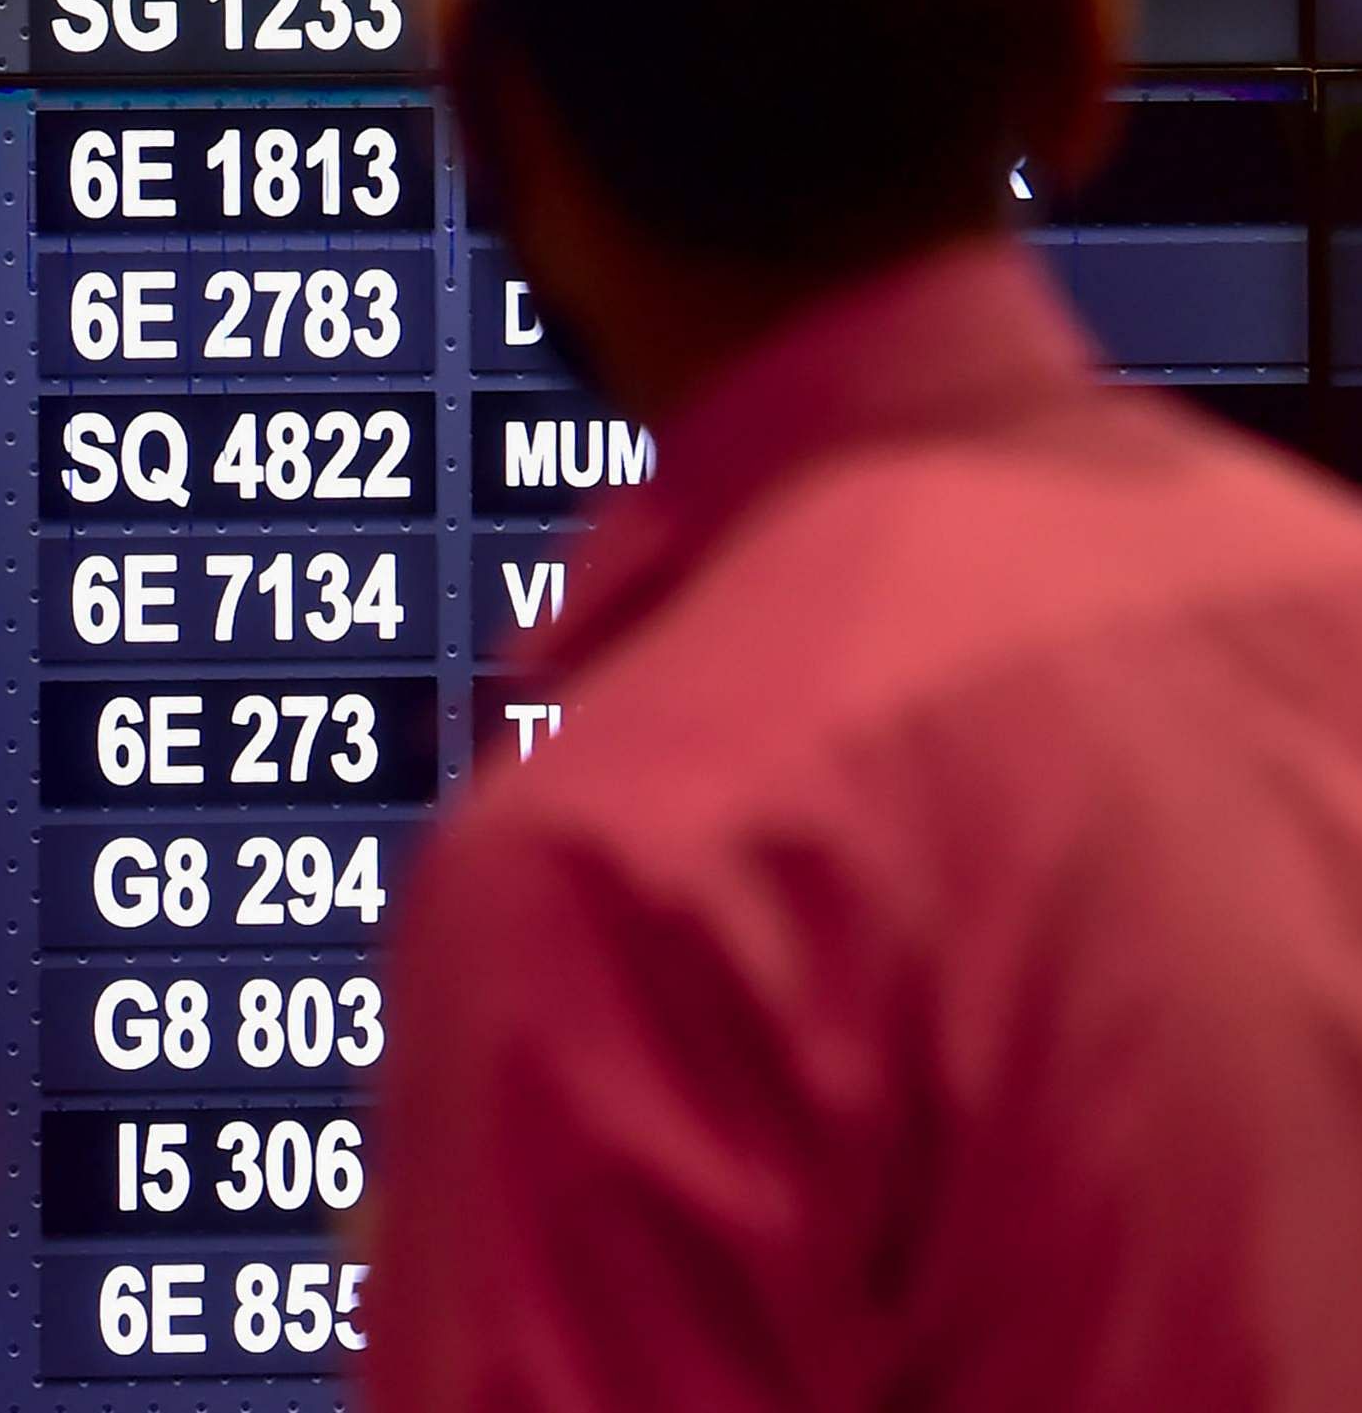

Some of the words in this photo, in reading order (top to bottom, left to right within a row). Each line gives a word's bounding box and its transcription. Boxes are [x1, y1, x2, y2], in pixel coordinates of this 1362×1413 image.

[69, 129, 177, 219] 6E
[206, 127, 400, 217] 1813
[70, 271, 178, 361] 6E
[203, 268, 401, 358] 2783
[61, 411, 191, 508] SQ
[213, 410, 411, 501] 4822
[505, 420, 655, 488] MUM
[72, 554, 179, 645] 6E
[206, 552, 404, 642] 7134
[97, 695, 205, 786] 6E
[230, 693, 379, 783] 273
[93, 837, 211, 928] G8
[235, 836, 386, 926] 294
[94, 979, 211, 1070] G8
[237, 977, 385, 1068] 803
[118, 1122, 191, 1212] I5
[215, 1119, 364, 1211] 306
[99, 1264, 207, 1356] 6E
[233, 1262, 368, 1353] 855
